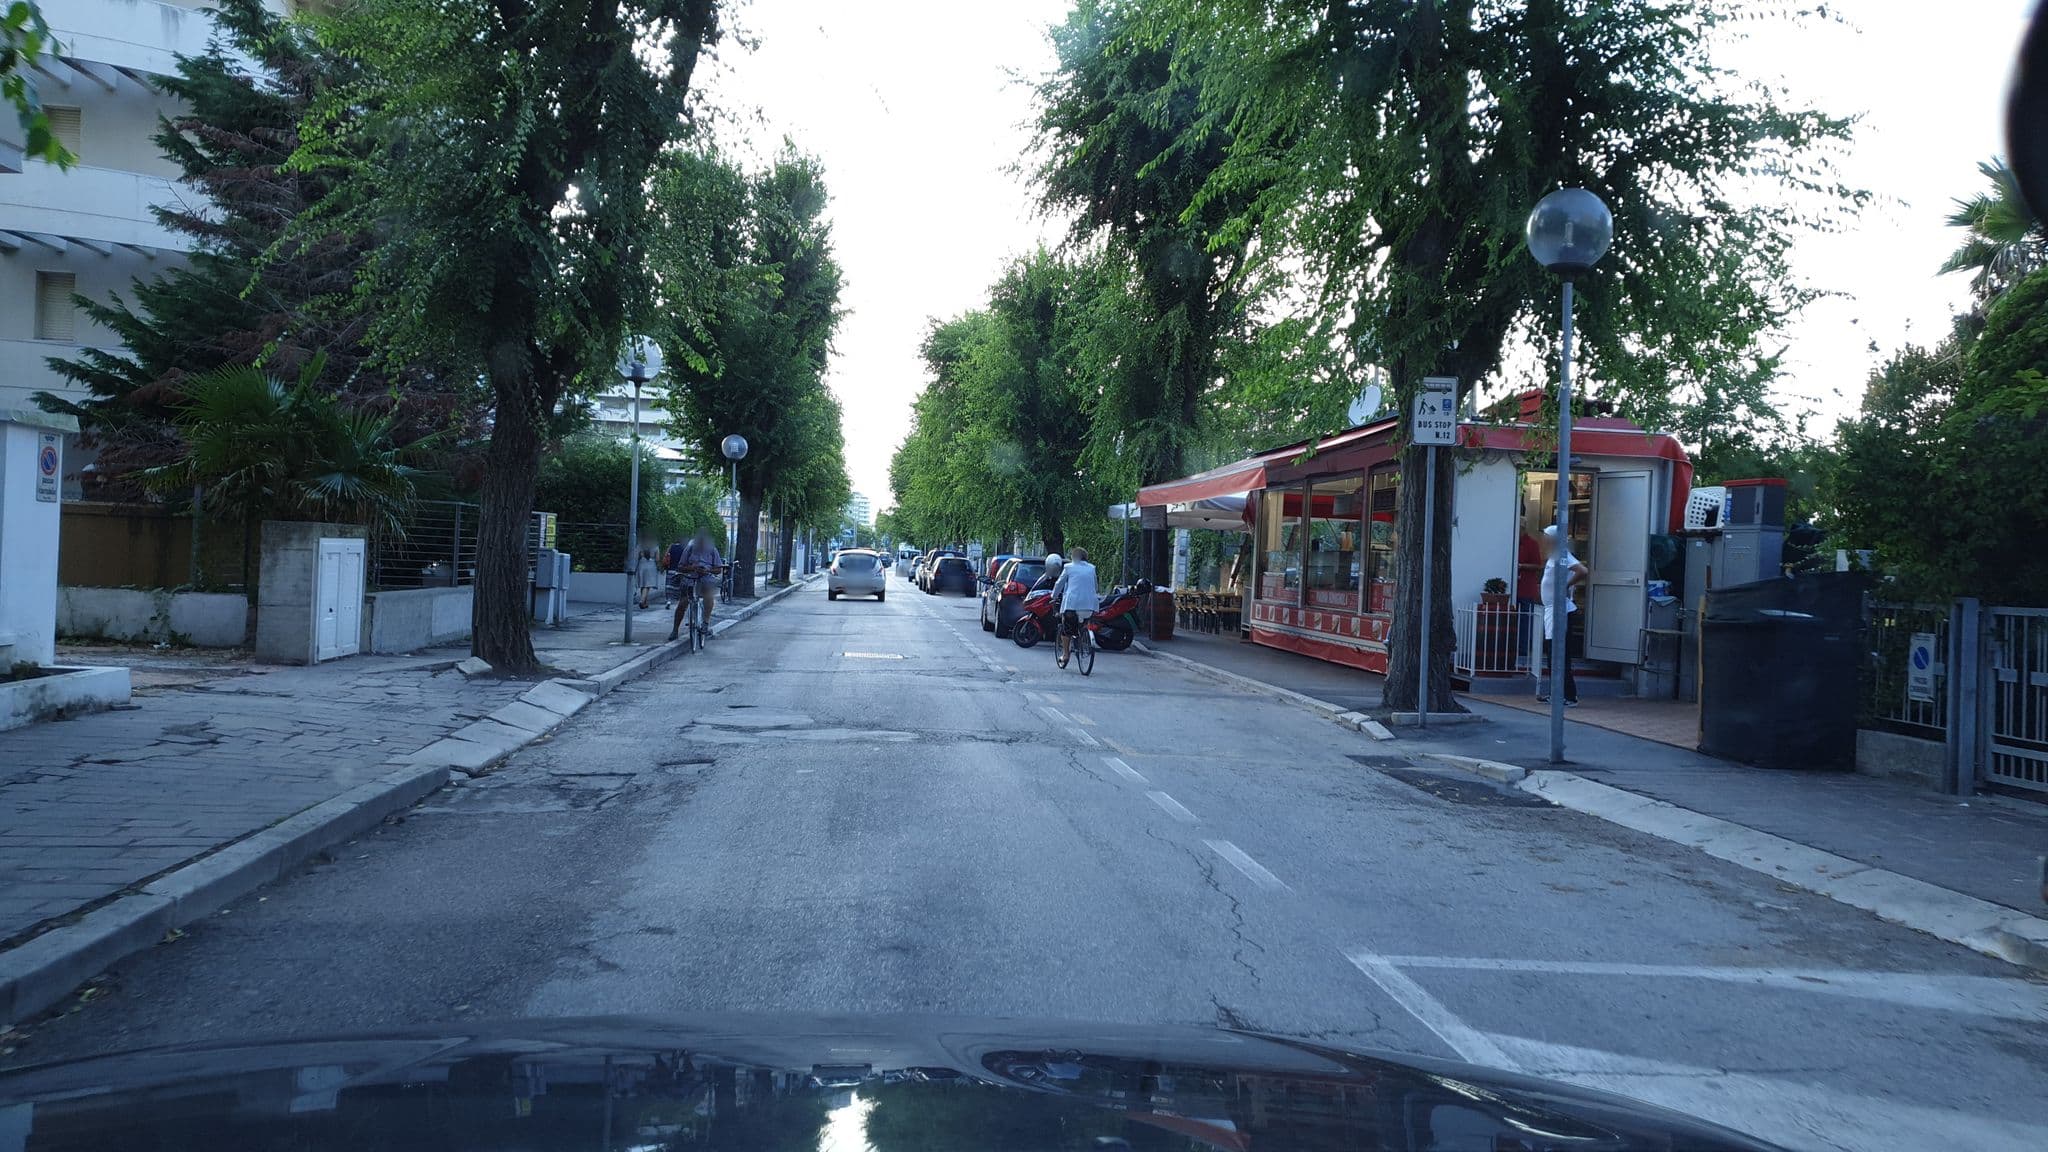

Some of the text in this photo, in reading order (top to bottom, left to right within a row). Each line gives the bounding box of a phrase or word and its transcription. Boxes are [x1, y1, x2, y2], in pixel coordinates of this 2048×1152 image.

[1418, 420, 1452, 429] BUS STOP
[1435, 431, 1451, 439] N.12
